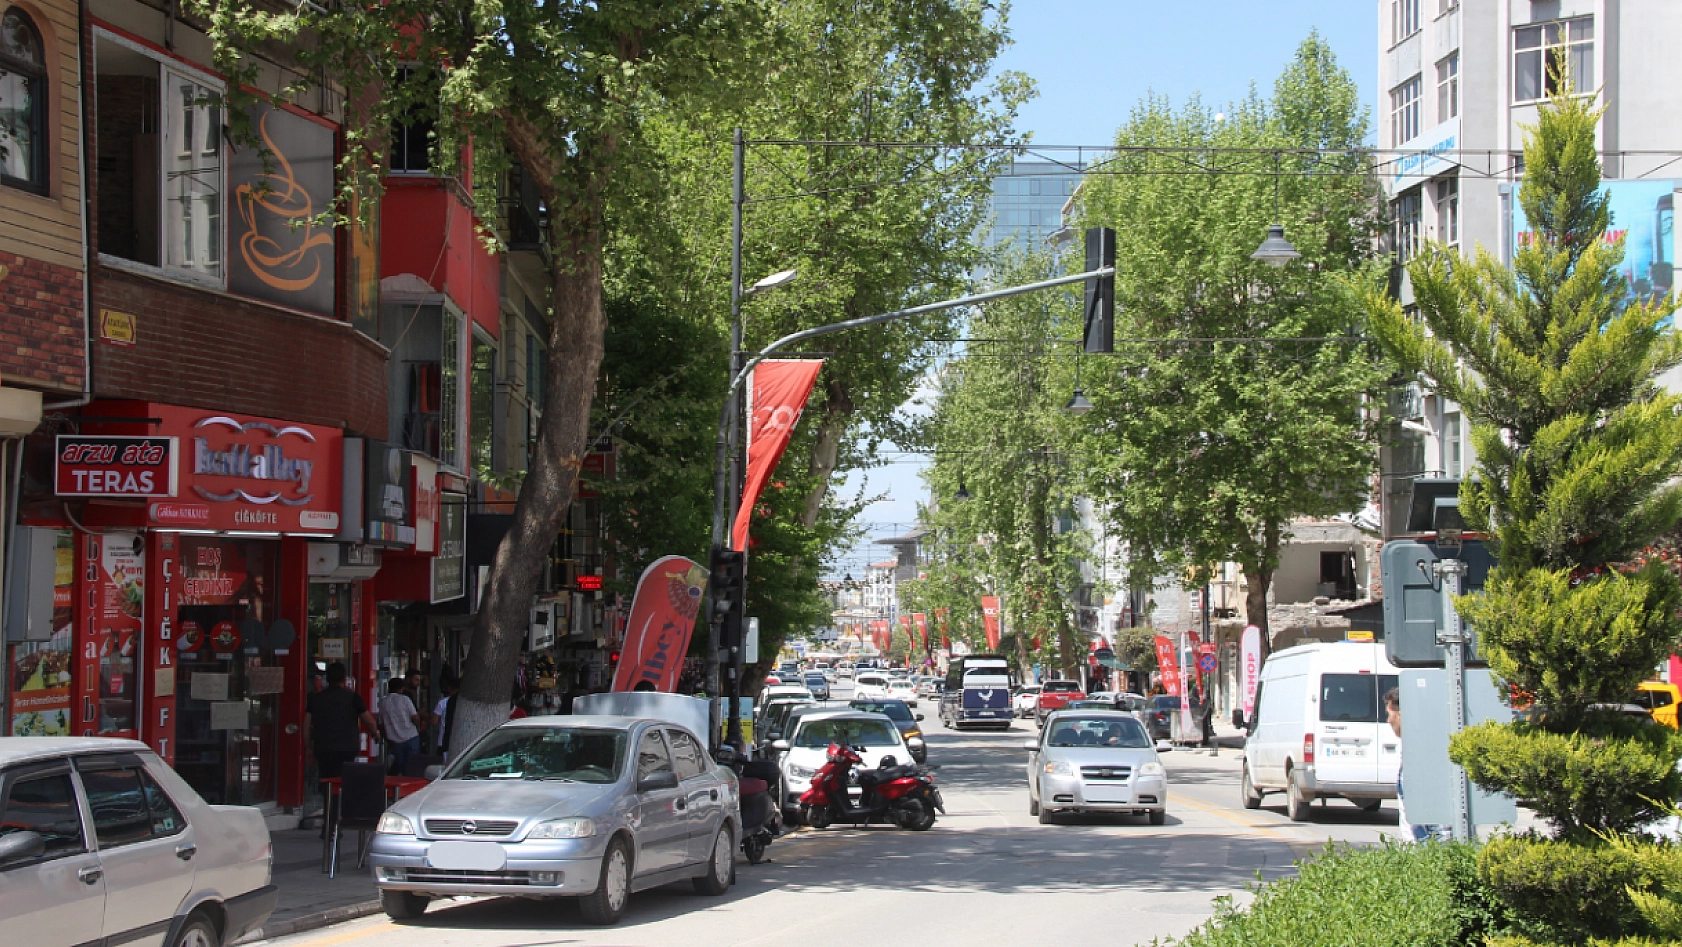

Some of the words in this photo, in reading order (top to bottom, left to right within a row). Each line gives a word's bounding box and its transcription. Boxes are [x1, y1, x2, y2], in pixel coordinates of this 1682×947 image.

[60, 442, 116, 465] arzu
[121, 439, 164, 466] ata
[71, 469, 156, 494] TERAS
[234, 509, 278, 525] ÇİĞKÖFTE
[158, 558, 173, 758] ÇİĞKFT
